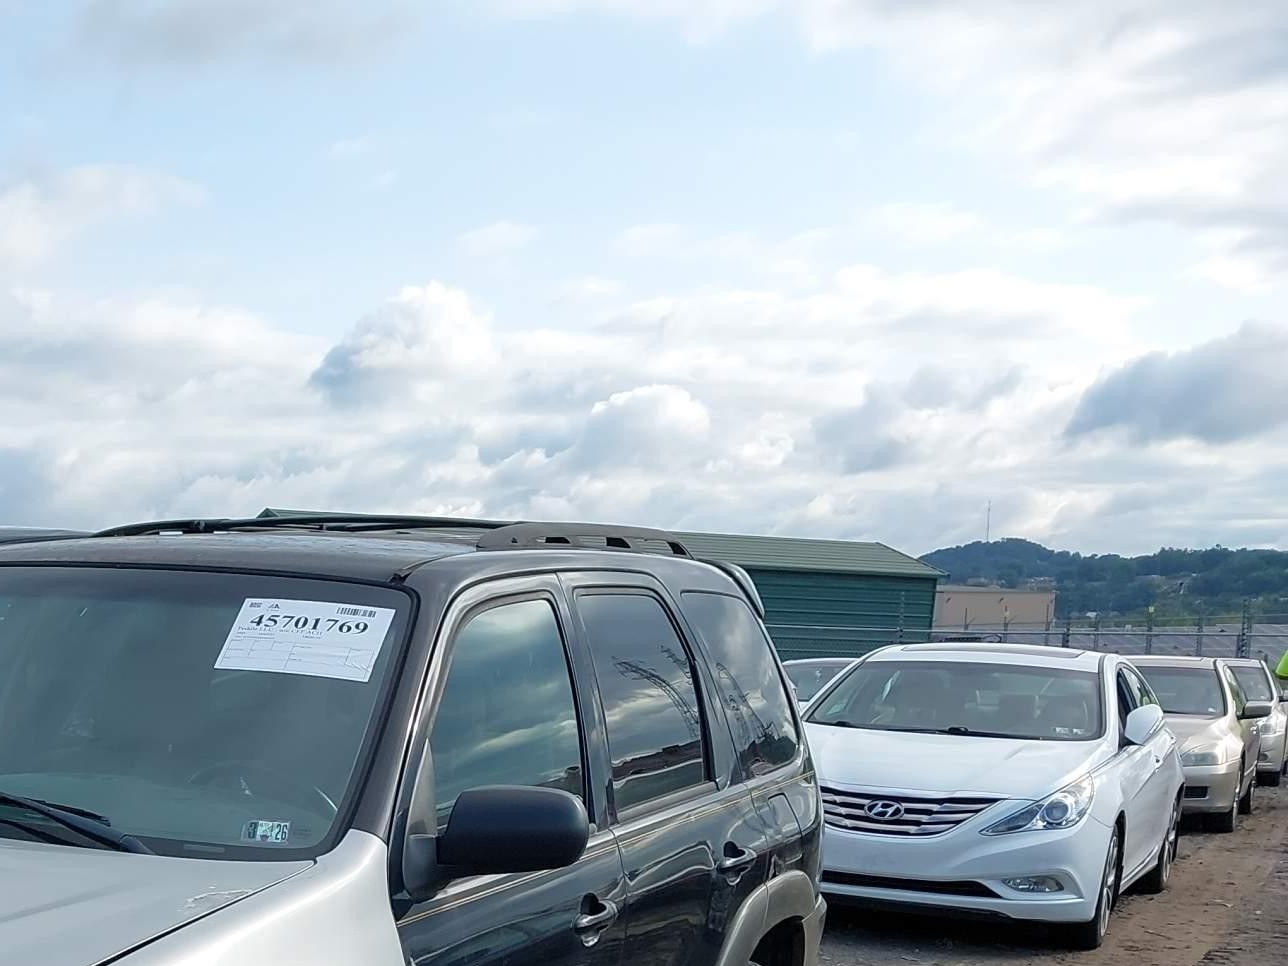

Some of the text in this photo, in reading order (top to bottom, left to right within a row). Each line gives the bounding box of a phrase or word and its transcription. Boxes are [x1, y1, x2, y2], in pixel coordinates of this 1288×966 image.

[250, 614, 368, 634] 45701769
[247, 822, 288, 841] 3 26
